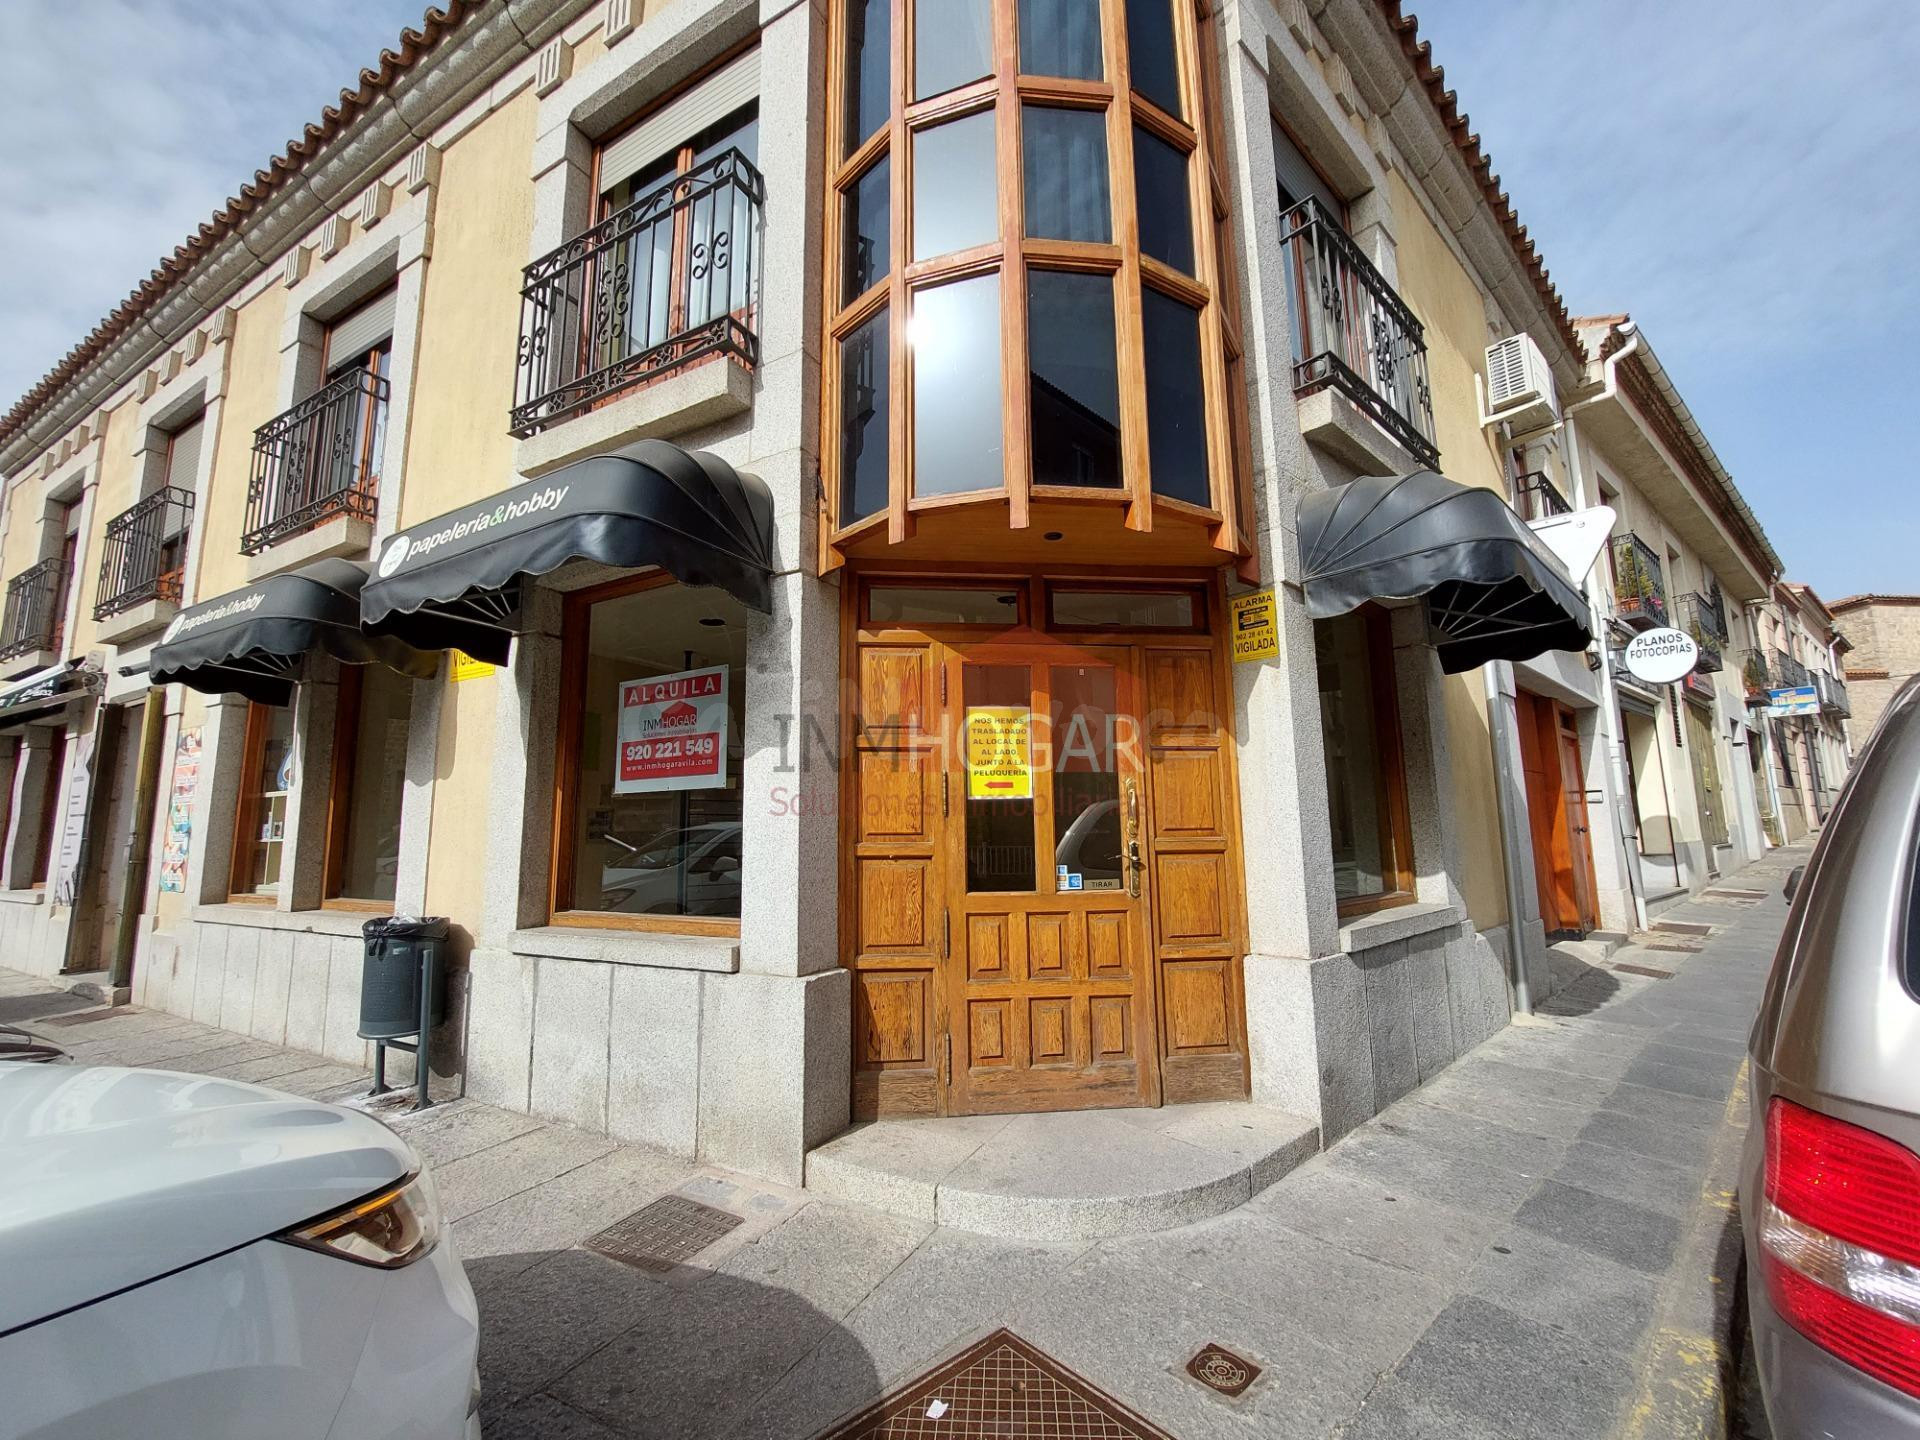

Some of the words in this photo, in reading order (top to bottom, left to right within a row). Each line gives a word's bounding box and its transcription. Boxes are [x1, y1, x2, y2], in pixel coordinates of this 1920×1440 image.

[405, 485, 570, 561] papelería&hobby
[1233, 594, 1273, 609] ALARMA
[1235, 637, 1275, 653] VIGILADA
[1636, 632, 1683, 647] PLANOS
[1630, 642, 1692, 659] FOTOCOPIAS
[629, 677, 716, 704] ALQUILA
[642, 713, 697, 730] INMHOGAR
[626, 744, 652, 762] 920
[655, 741, 682, 759] 221
[685, 737, 714, 756] 549
[626, 758, 713, 772] www.inmhogaravila.com
